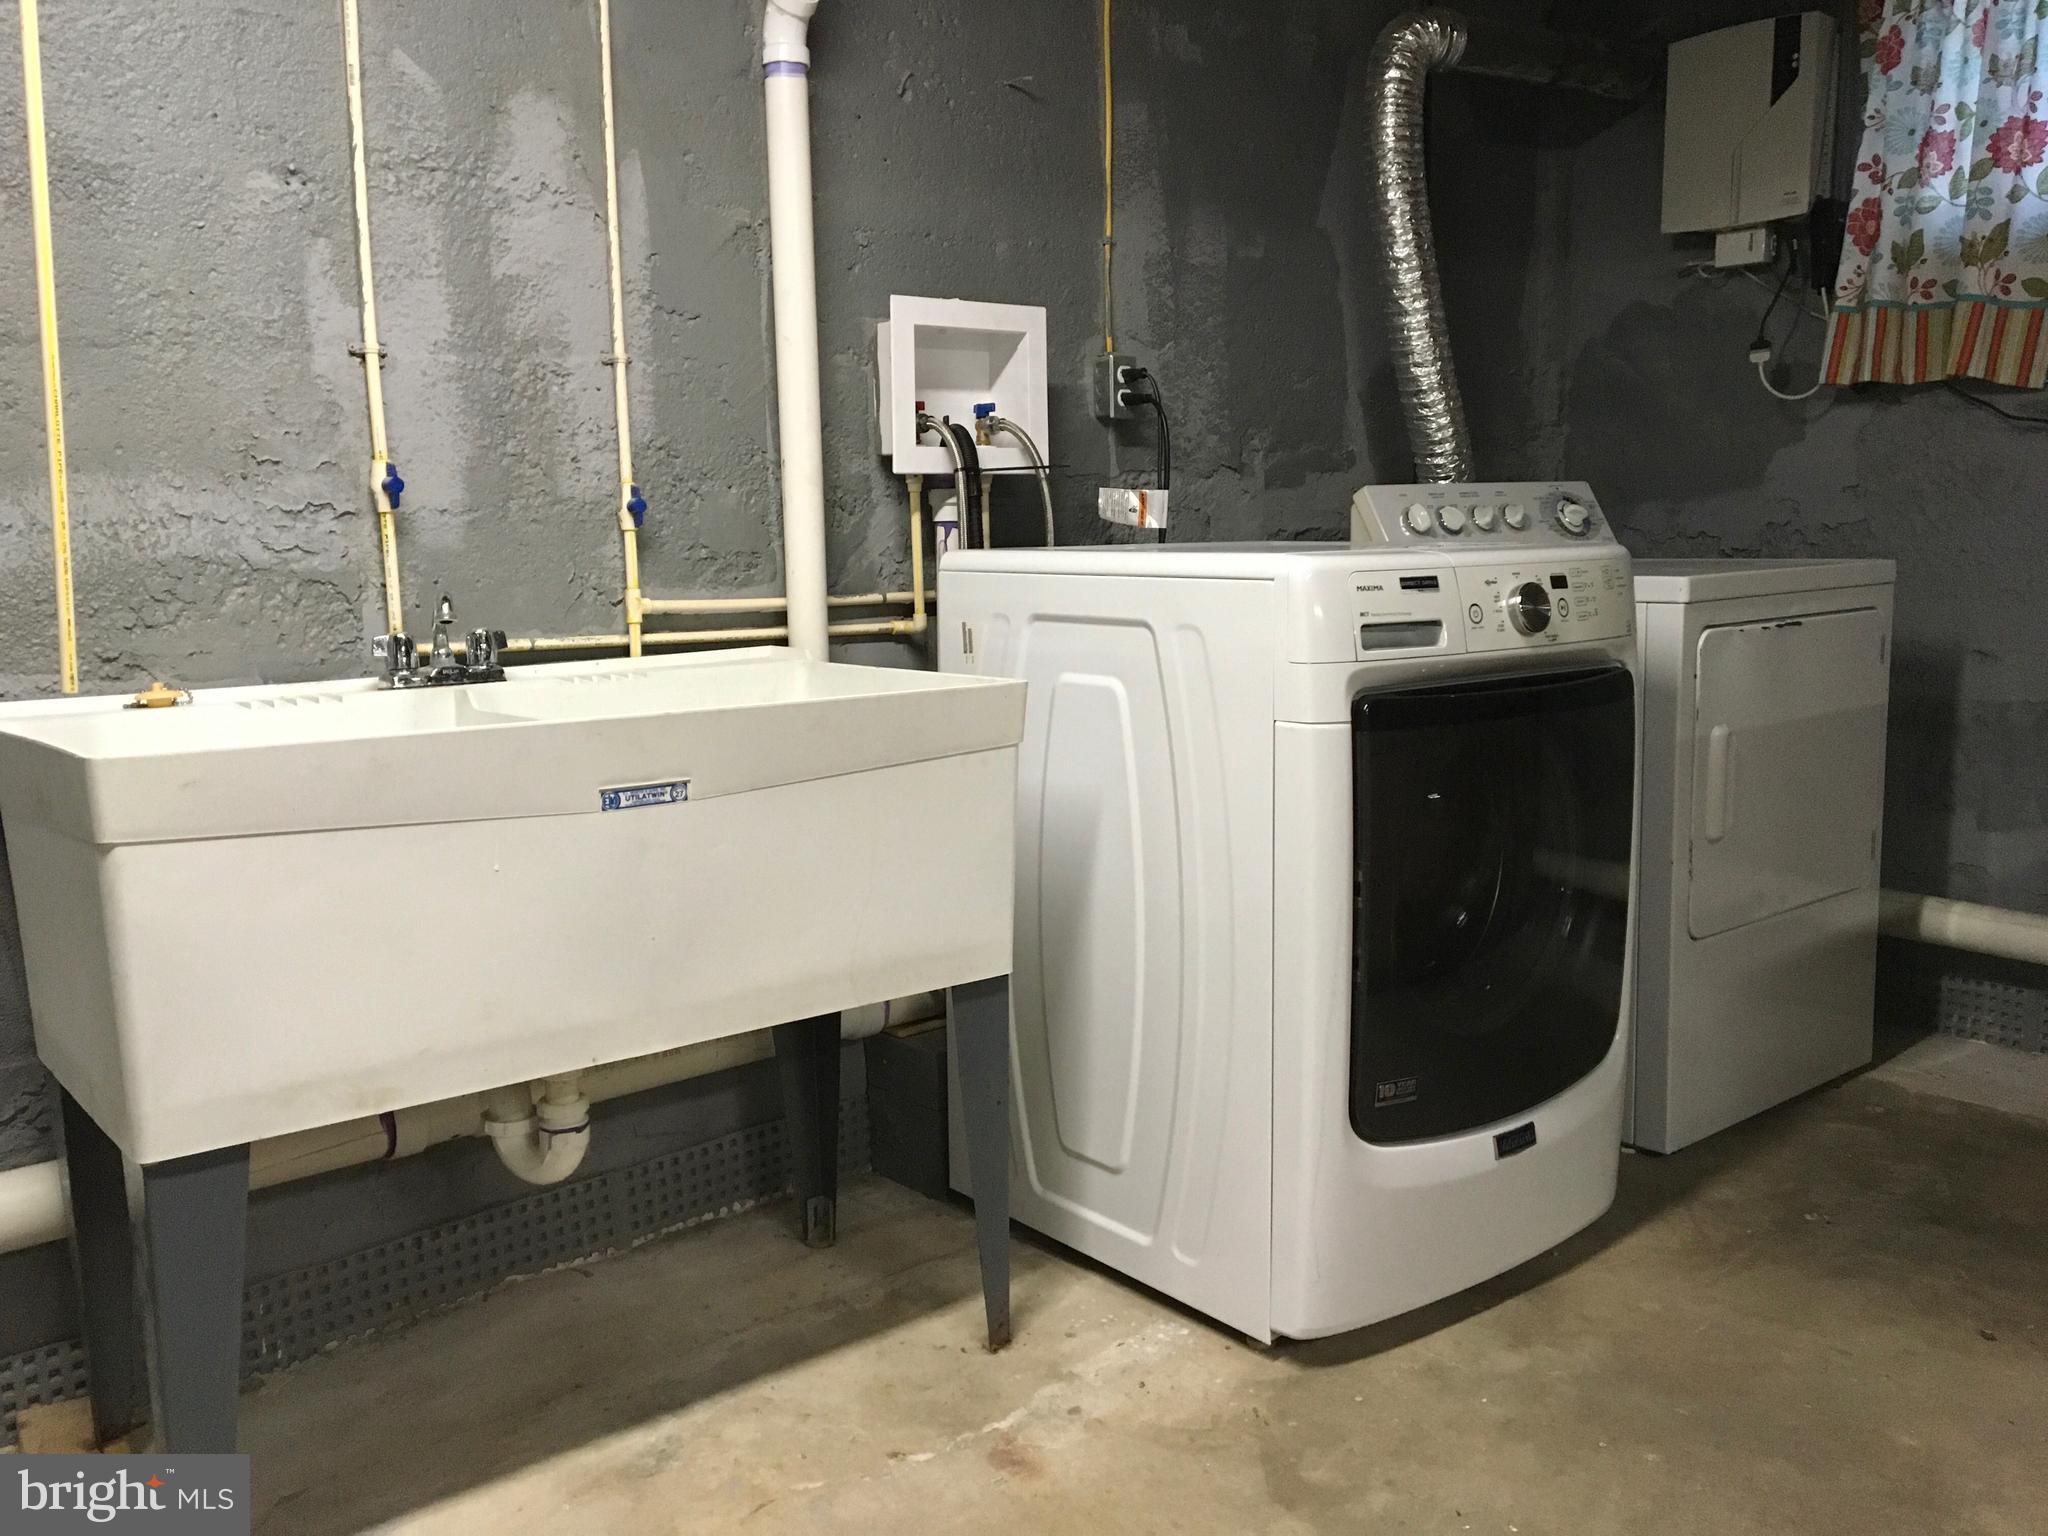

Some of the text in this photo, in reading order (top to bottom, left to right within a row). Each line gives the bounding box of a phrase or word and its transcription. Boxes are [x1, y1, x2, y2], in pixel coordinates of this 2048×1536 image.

[1356, 584, 1384, 592] MAXIMA
[624, 791, 665, 802] UTILATWIN
[675, 790, 684, 798] 27
[1379, 1083, 1396, 1098] 10
